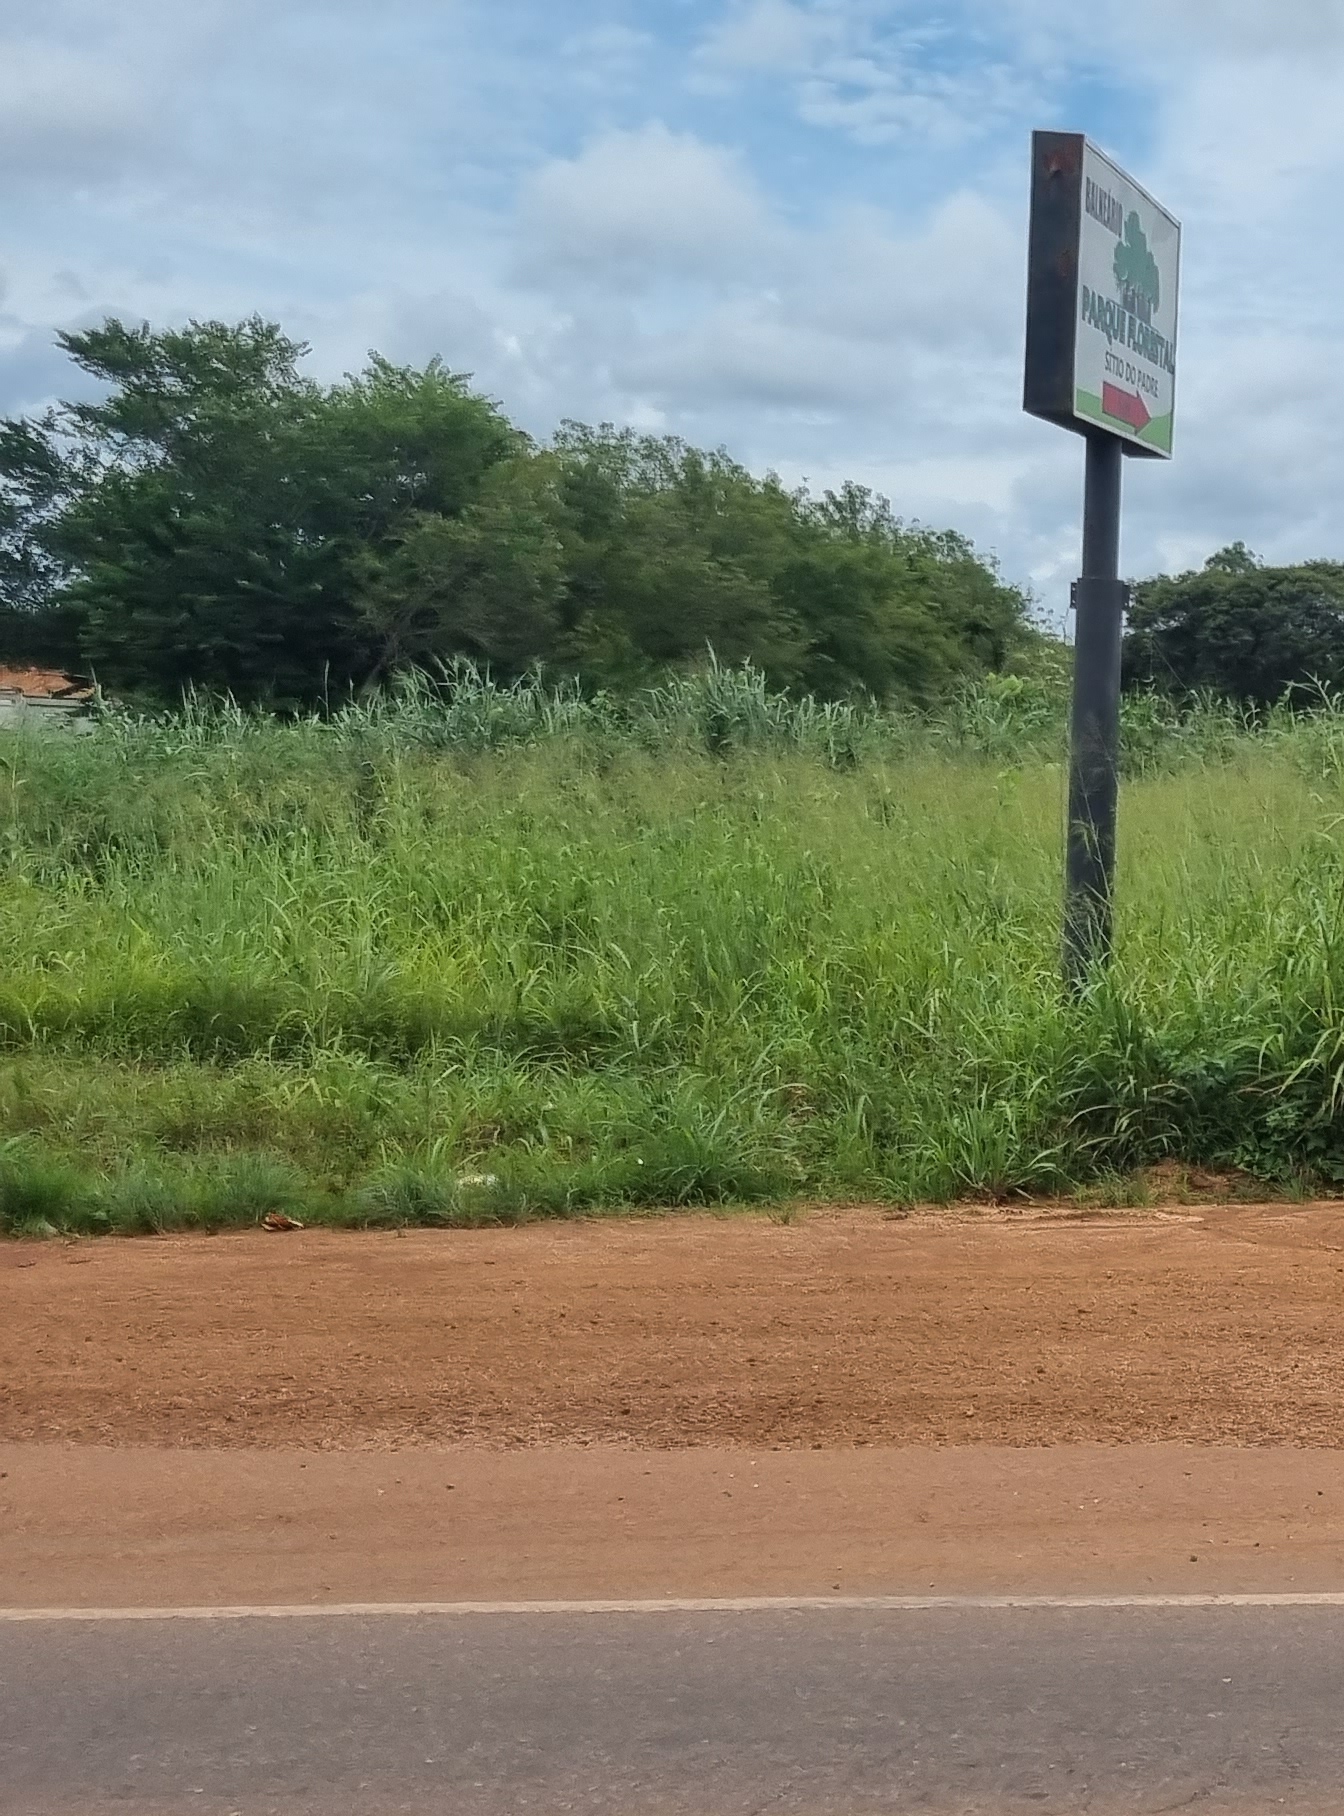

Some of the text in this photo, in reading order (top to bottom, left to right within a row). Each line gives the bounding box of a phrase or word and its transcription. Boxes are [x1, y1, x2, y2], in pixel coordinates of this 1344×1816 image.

[1086, 176, 1123, 238] BALNEÁRIO
[1081, 284, 1175, 376] PARQUE FLORESTAL
[1125, 362, 1136, 386] DO
[1137, 370, 1160, 399] PADRE
